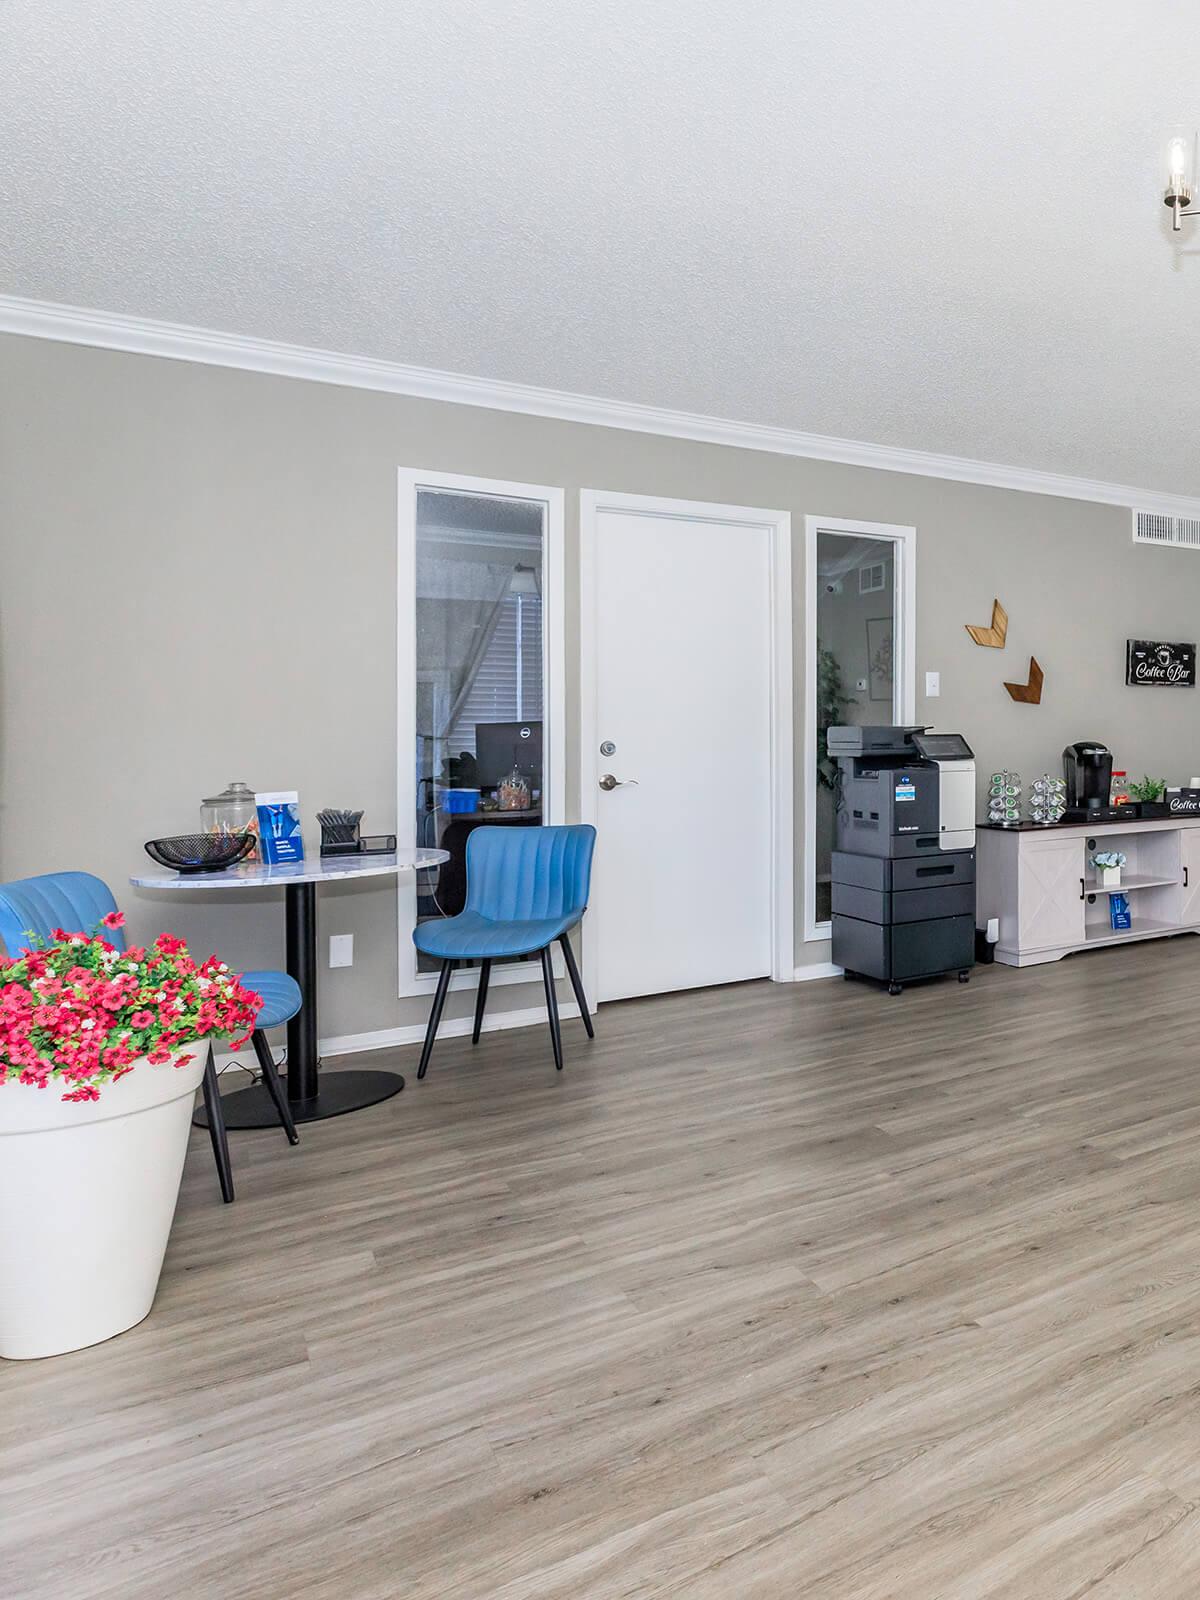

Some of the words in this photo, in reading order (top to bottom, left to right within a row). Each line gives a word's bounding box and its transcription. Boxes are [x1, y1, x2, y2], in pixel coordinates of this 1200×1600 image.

[1136, 662, 1165, 678] Coffee
[1167, 664, 1190, 681] Bar
[1170, 798, 1197, 810] Coffee
